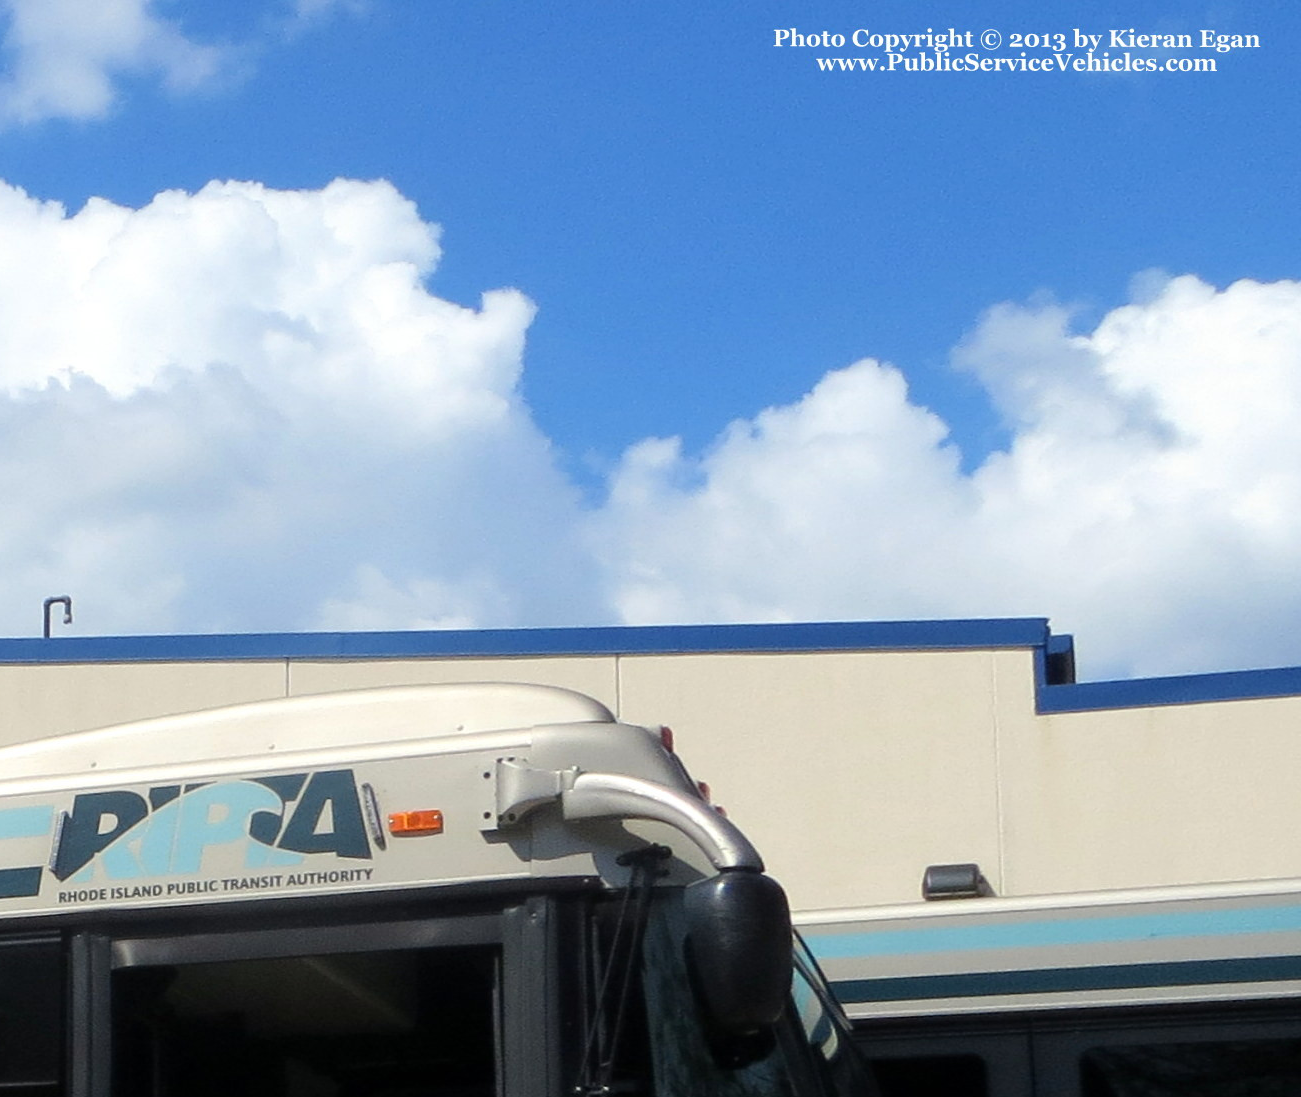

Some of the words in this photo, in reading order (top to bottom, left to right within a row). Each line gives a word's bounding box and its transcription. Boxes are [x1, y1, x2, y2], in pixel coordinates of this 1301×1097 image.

[57, 889, 108, 904] RHODE
[110, 884, 163, 900] ISLAND
[166, 879, 219, 896] PUBLIC
[222, 875, 284, 892] TRANSIT
[286, 868, 375, 887] AUTHORITY
